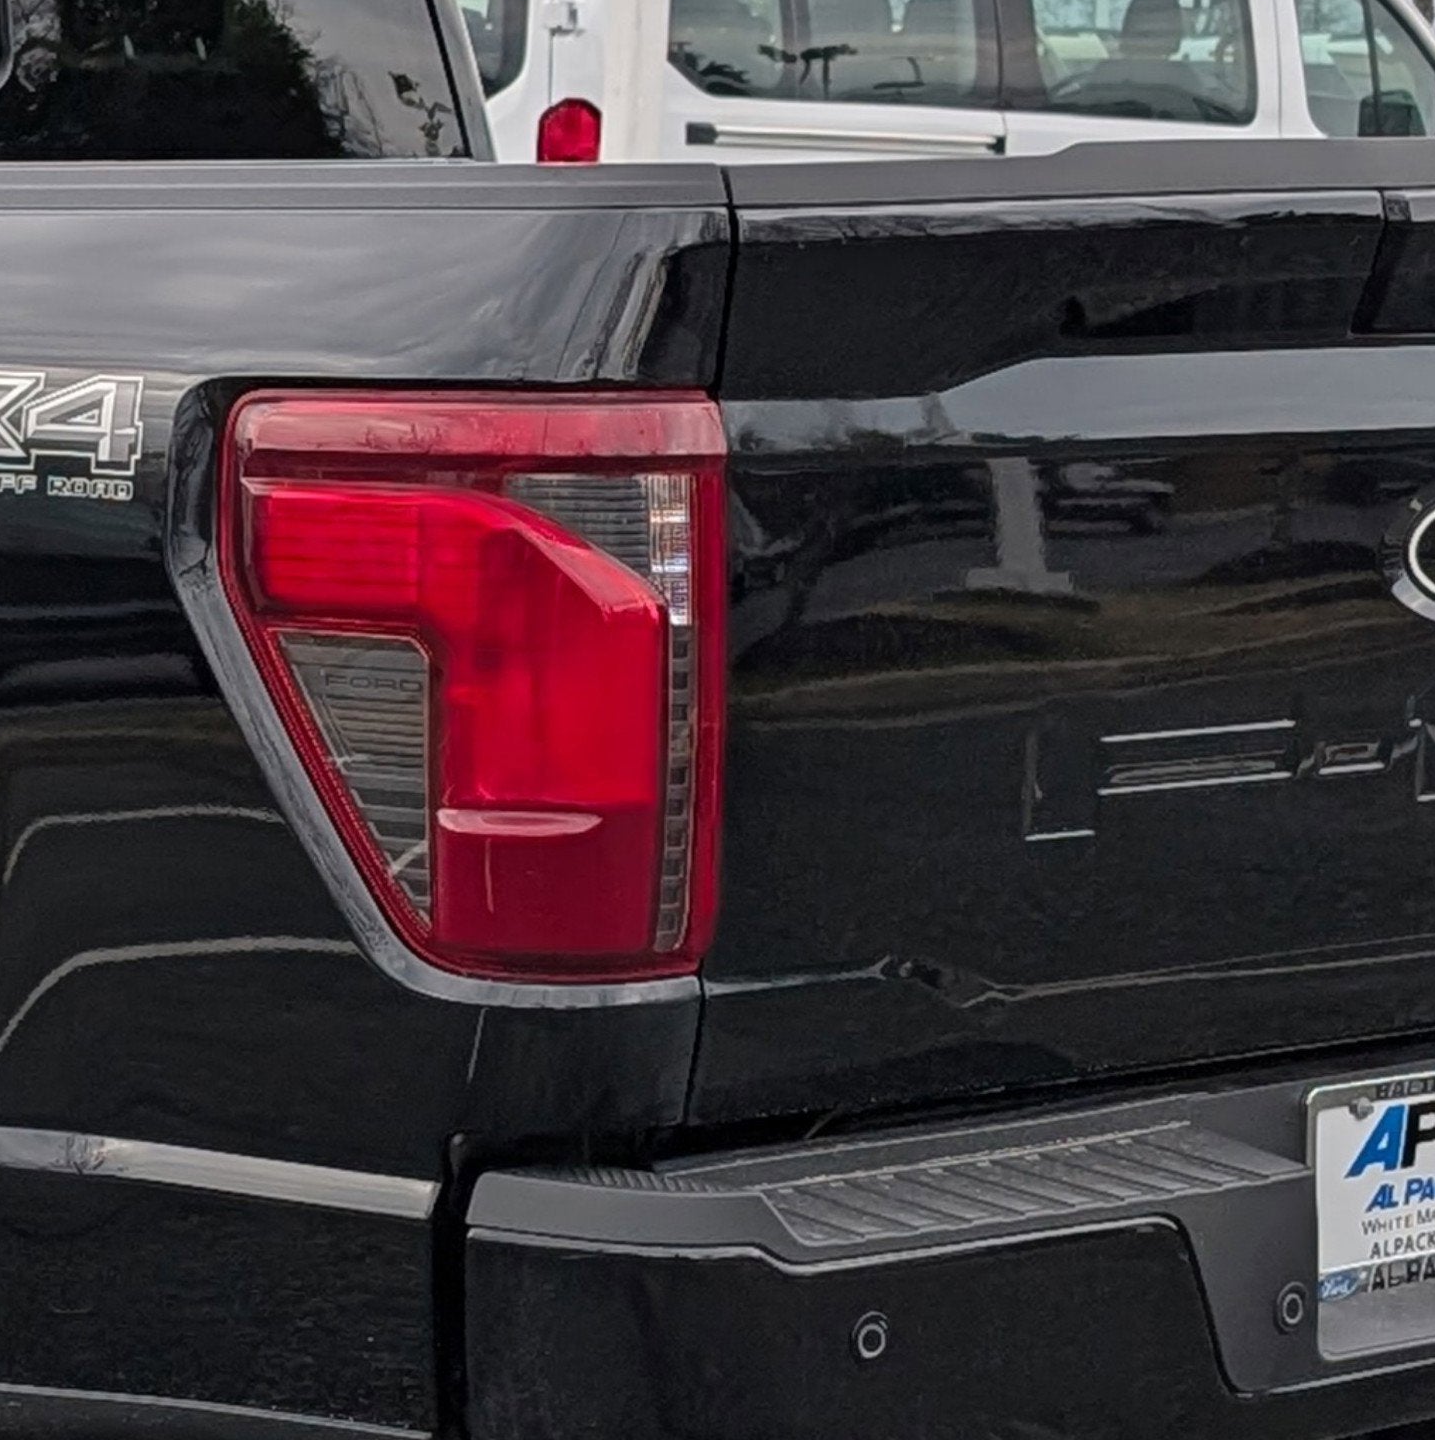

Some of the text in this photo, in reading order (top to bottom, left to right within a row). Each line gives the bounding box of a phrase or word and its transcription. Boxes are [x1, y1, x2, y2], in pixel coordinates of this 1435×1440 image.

[47, 475, 133, 500] ROAD
[325, 673, 423, 693] FORD
[1365, 1183, 1398, 1213] AL
